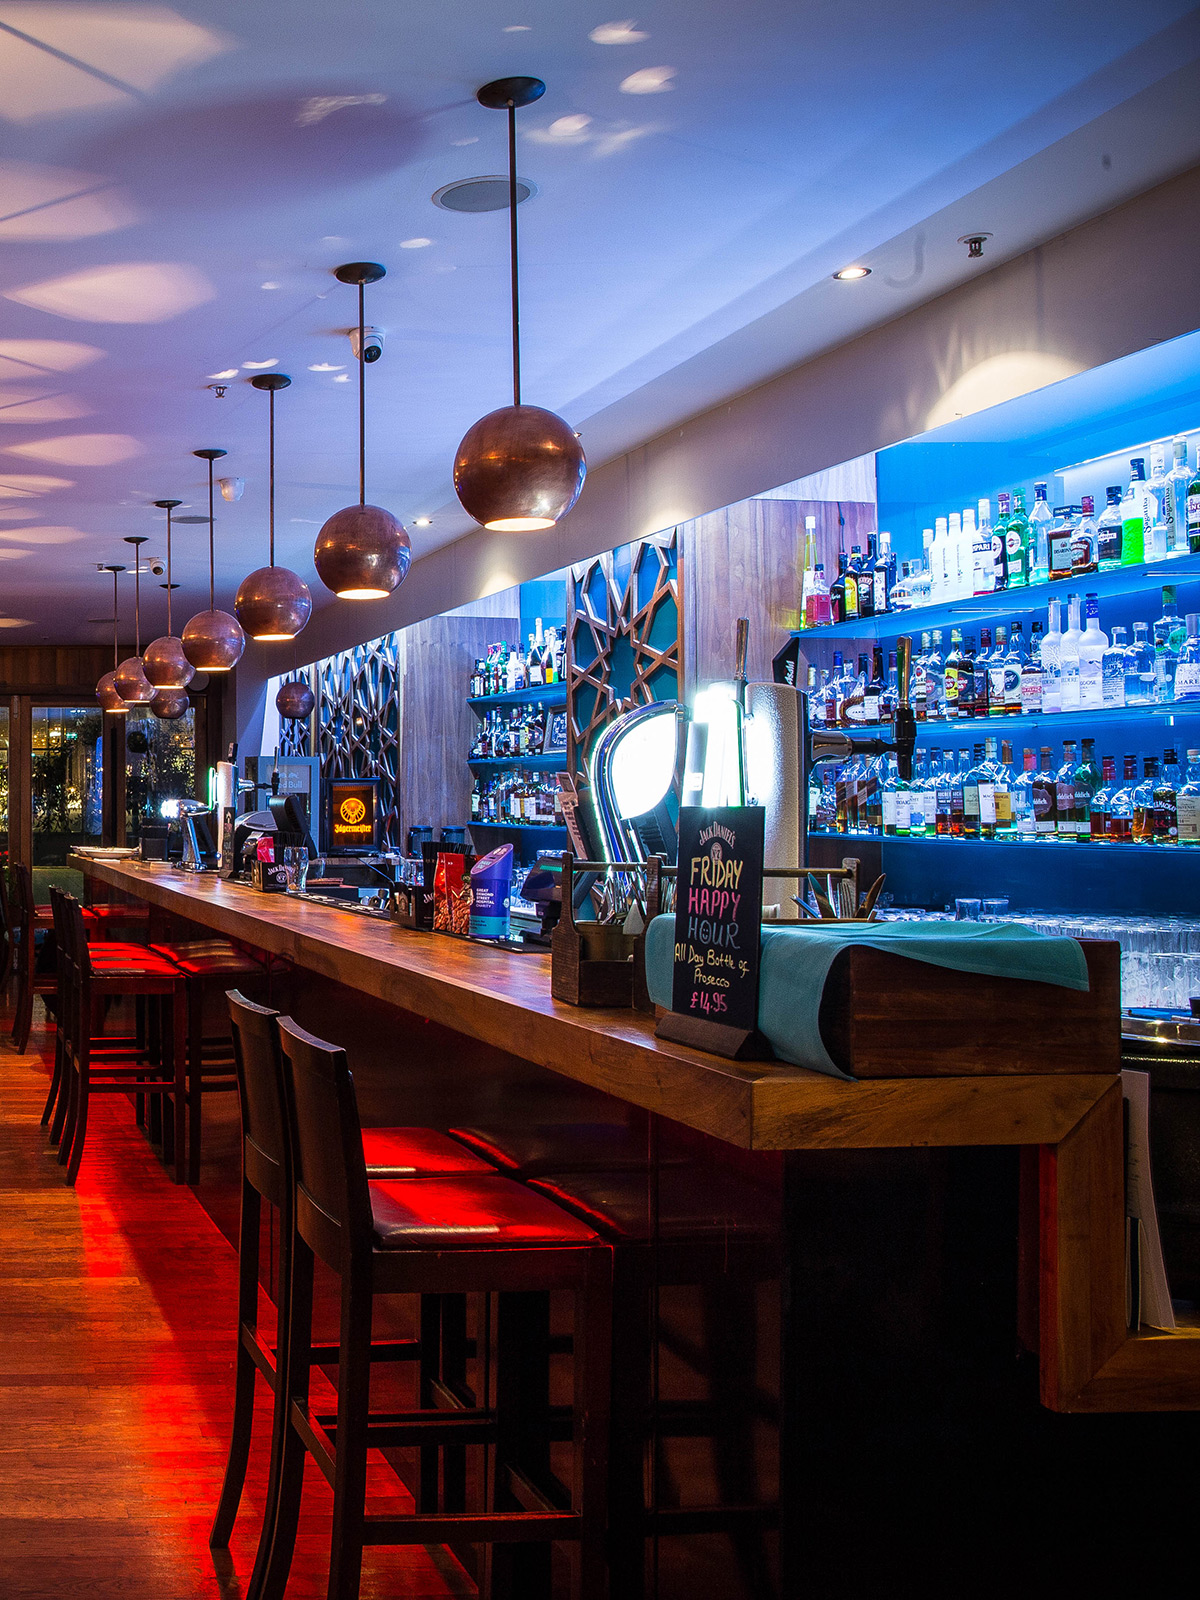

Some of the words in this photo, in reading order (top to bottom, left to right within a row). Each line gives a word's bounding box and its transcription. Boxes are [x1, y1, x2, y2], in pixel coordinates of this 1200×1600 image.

[699, 826, 713, 846] JACK
[714, 821, 736, 849] DANIEL'S
[690, 856, 743, 889] FRIDAY
[688, 887, 741, 921] HAPPY
[687, 916, 741, 949] HOUR
[674, 943, 687, 962] All
[688, 945, 705, 968] Day
[707, 949, 736, 969] Bottle
[738, 960, 750, 978] of
[694, 968, 731, 988] Prosecco
[690, 991, 728, 1014] £14.95
